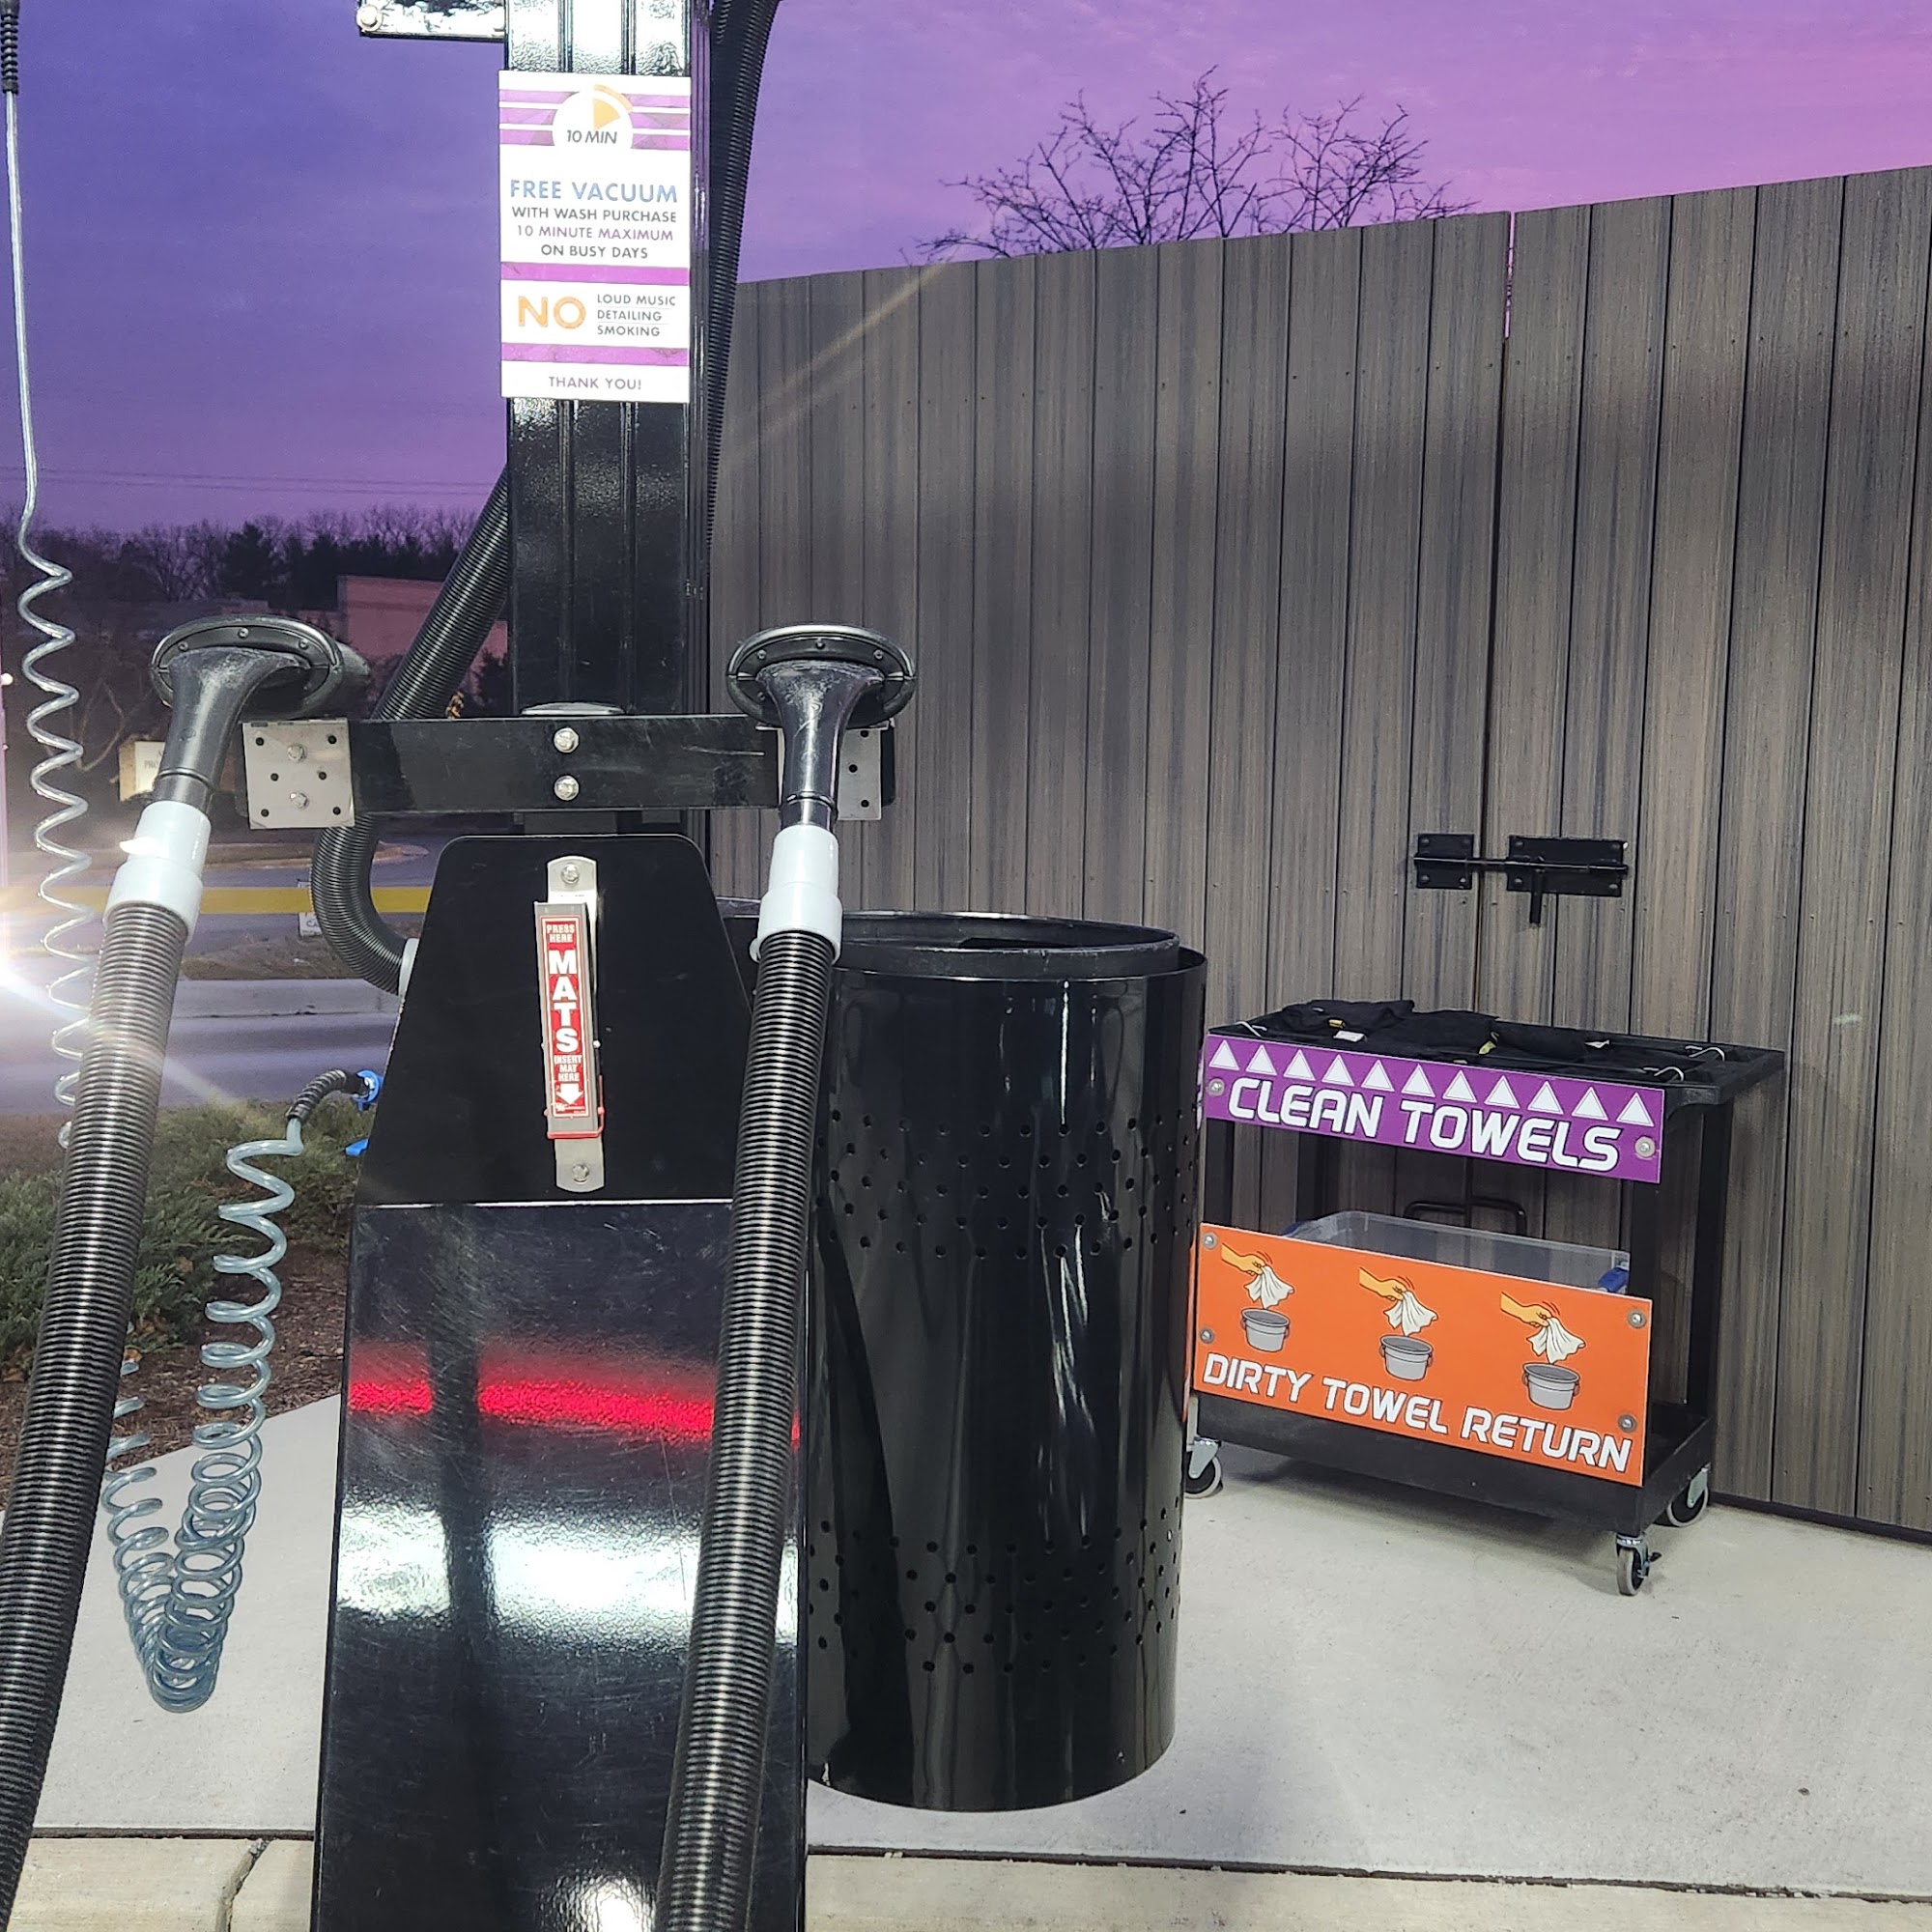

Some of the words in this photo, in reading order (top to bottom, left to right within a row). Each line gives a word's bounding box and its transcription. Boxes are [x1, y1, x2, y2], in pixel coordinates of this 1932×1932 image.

[567, 130, 582, 143] 10
[584, 130, 617, 144] MIN
[510, 180, 561, 199] FREE
[572, 182, 677, 203] VACUUM
[512, 207, 549, 218] WITH
[554, 208, 597, 220] WASH
[603, 210, 676, 223] PURCHASE
[518, 225, 533, 237] 10
[539, 226, 592, 239] MINUTE
[598, 228, 673, 241] MAXIMUM
[541, 244, 564, 256] ON
[570, 245, 606, 258] BUSY
[612, 246, 648, 259] DAYS
[597, 294, 631, 304] LOUD
[637, 296, 676, 306] MUSIC
[518, 296, 586, 329] NO
[597, 309, 663, 322] DETAILING
[597, 325, 661, 336] SMOKING
[549, 376, 599, 389] THANK
[605, 378, 641, 390] YOU!
[546, 923, 576, 934] PRESS
[549, 933, 574, 943] HERE
[548, 950, 579, 1053] MATS
[554, 1054, 582, 1065] INSERT
[558, 1064, 578, 1073] MAT
[557, 1072, 580, 1082] HERE
[1228, 1077, 1383, 1138] CLEAN
[1400, 1098, 1623, 1173] TOWELS
[1202, 1352, 1314, 1403] DIRTY
[1321, 1378, 1448, 1435] TOWEL
[1462, 1406, 1633, 1474] RETURN
